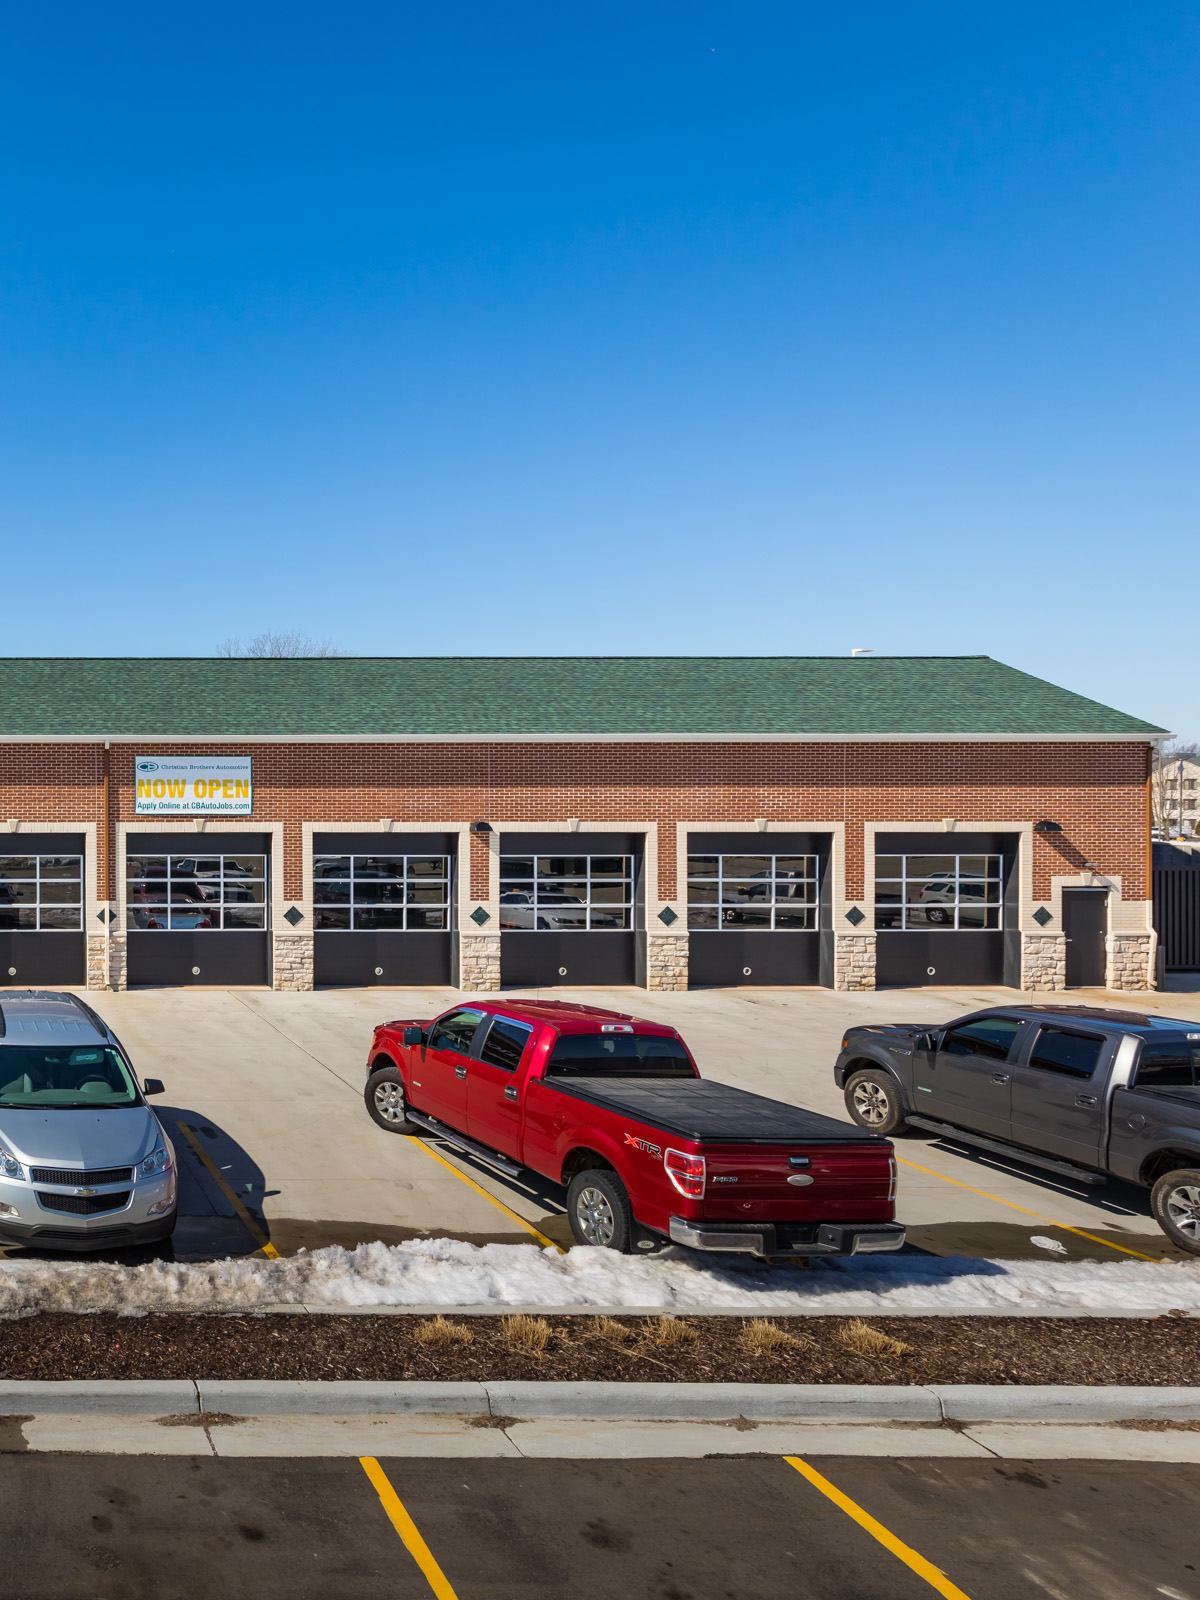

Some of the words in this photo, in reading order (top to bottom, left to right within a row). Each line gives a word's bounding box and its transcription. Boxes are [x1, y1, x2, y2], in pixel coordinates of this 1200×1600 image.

[137, 778, 187, 798] NOW
[194, 778, 249, 798] OPEN
[137, 801, 157, 811] Apply
[158, 801, 181, 810] Online
[182, 802, 190, 810] at
[191, 801, 250, 810] CBAutoJobs.com
[624, 1132, 664, 1159] XTR
